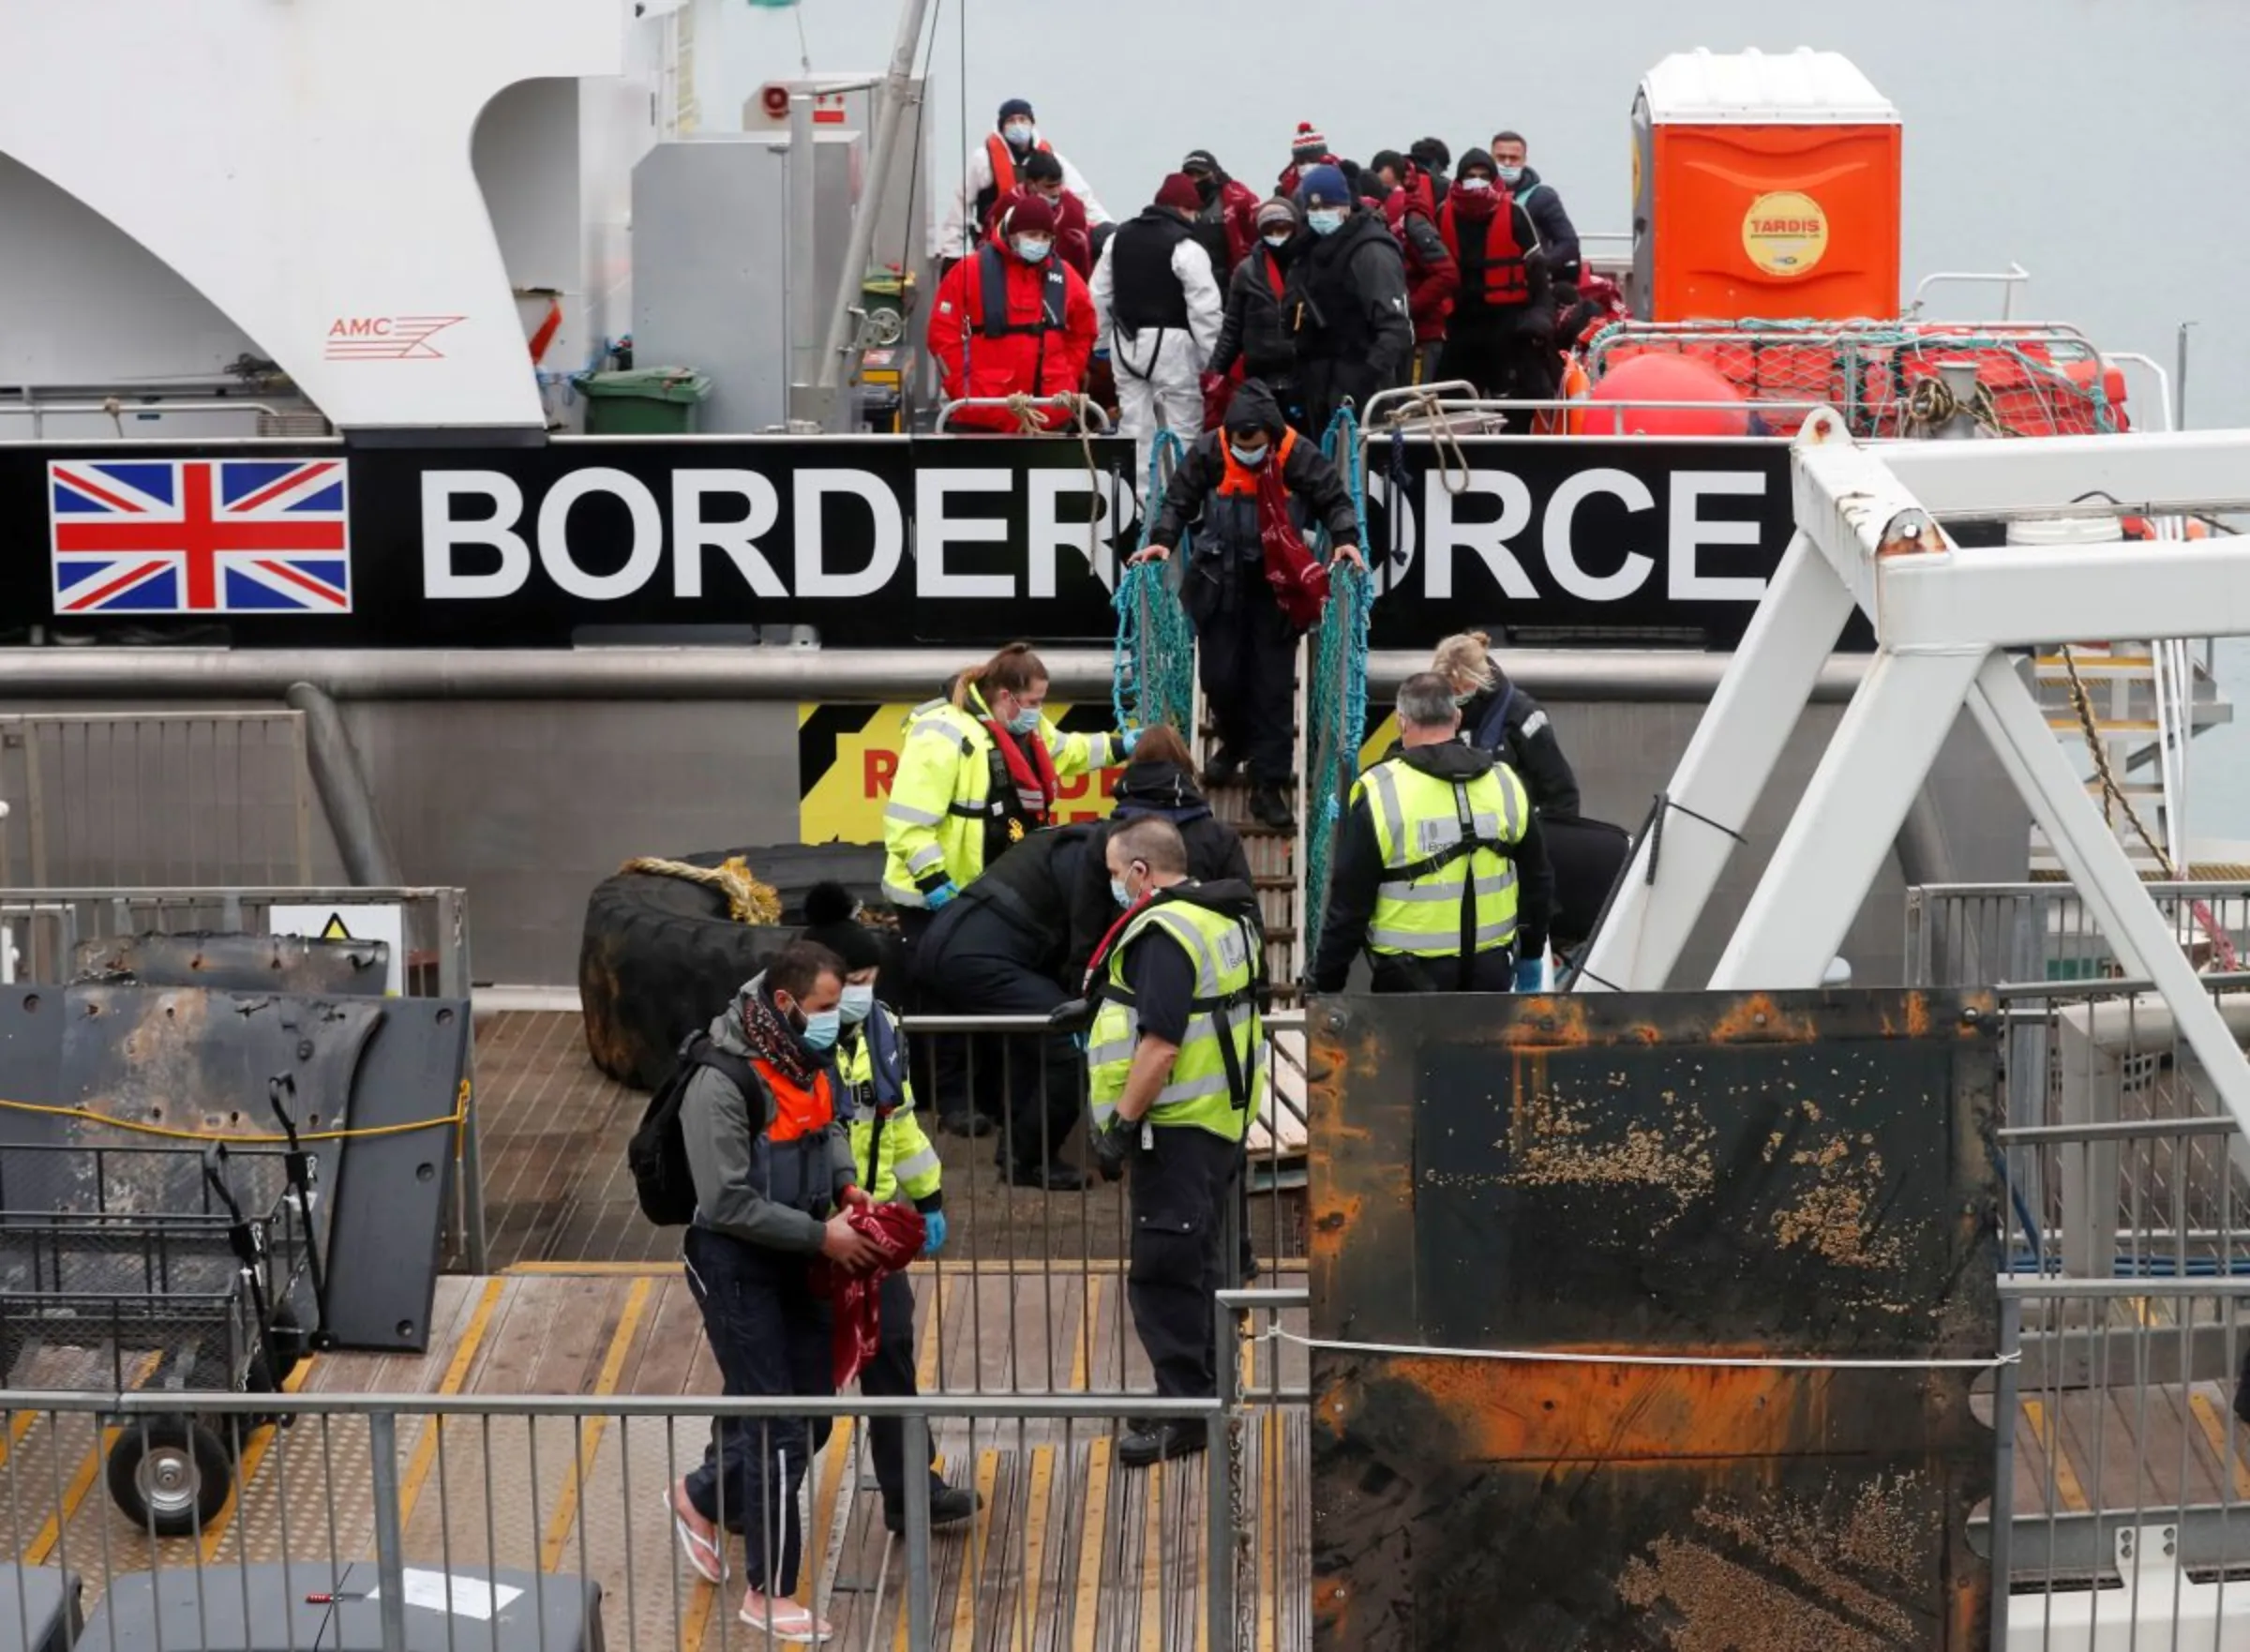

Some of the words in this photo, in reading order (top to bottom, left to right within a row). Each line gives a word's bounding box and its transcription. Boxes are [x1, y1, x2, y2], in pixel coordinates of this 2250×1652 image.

[1749, 218, 1821, 233] TARDIS
[328, 317, 392, 338] AMC
[420, 466, 1135, 601] BORDER
[1367, 467, 1768, 601] RCE
